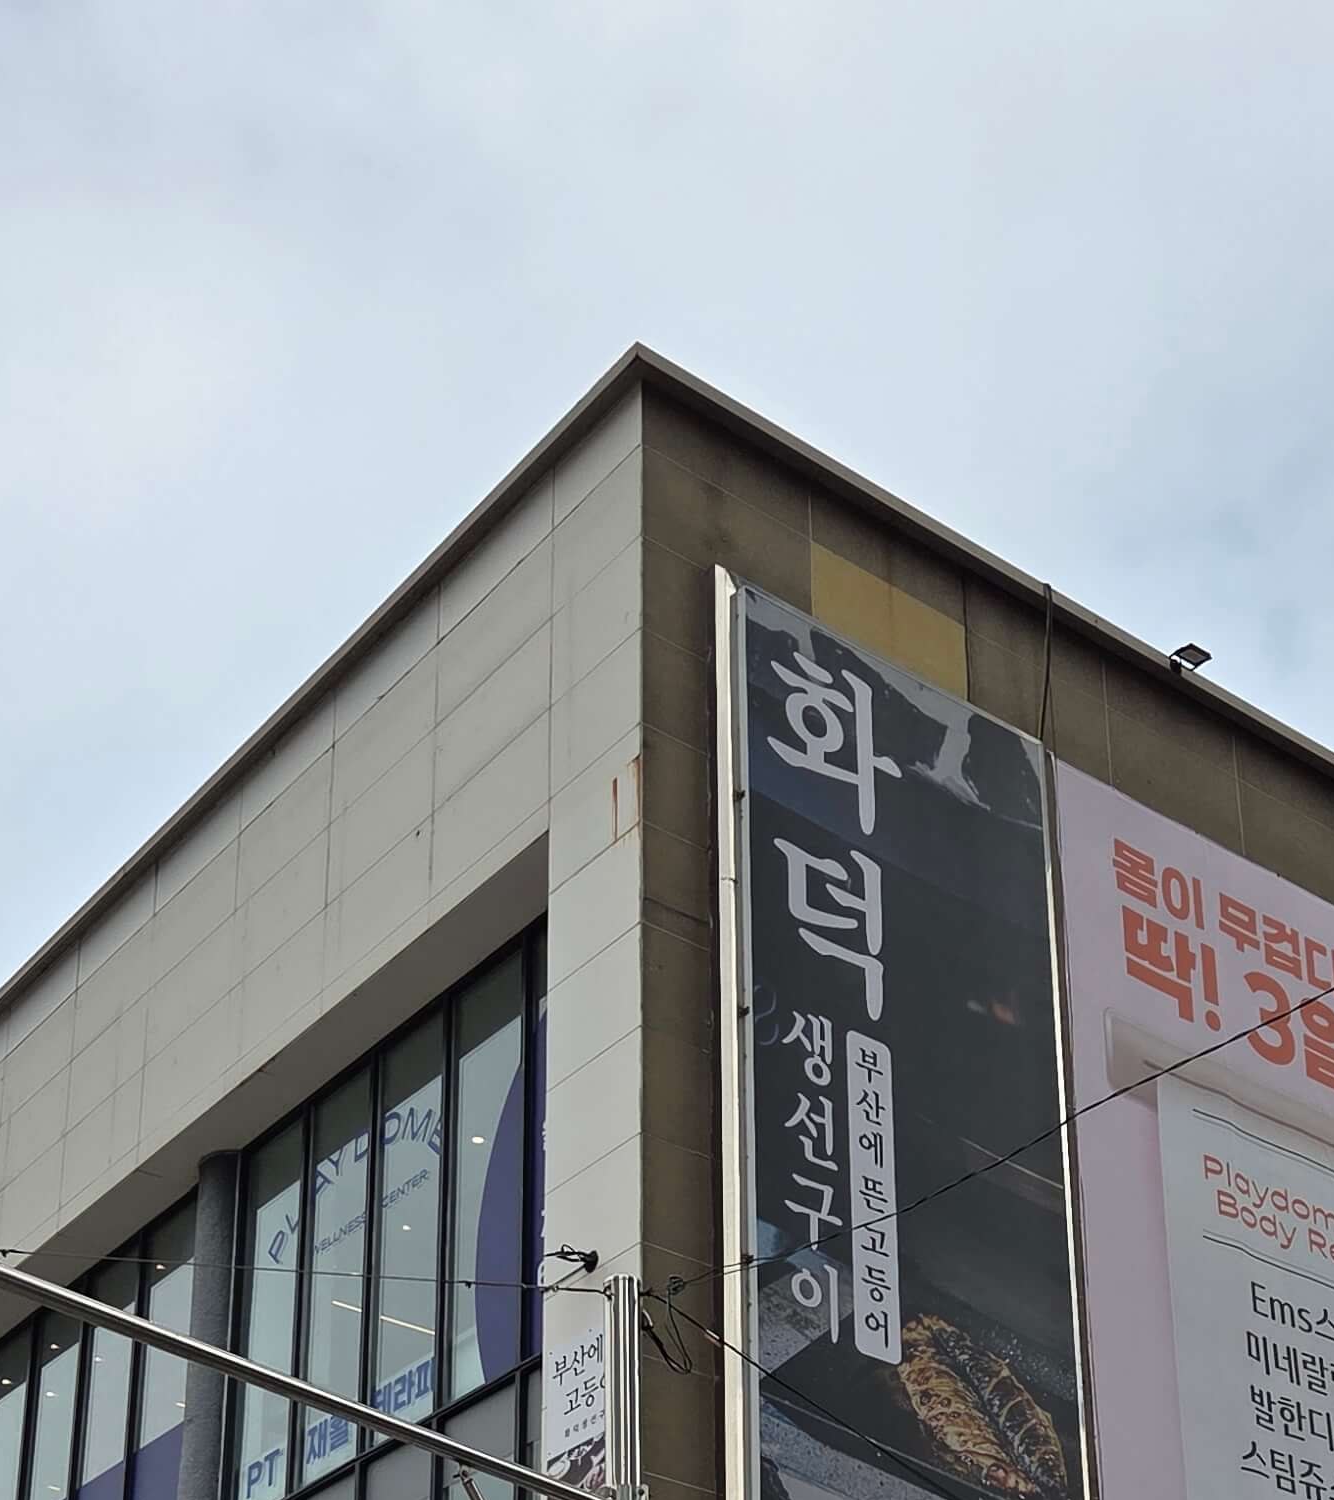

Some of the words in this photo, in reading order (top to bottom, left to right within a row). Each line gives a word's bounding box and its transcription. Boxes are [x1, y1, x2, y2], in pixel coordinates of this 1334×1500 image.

[1113, 838, 1204, 930] 몸이
[1122, 904, 1222, 1032] 딱!
[381, 1168, 429, 1208] CENTER
[782, 1010, 842, 1344] 생선구이
[1217, 1190, 1298, 1250] Body
[552, 1333, 604, 1386] 부산에
